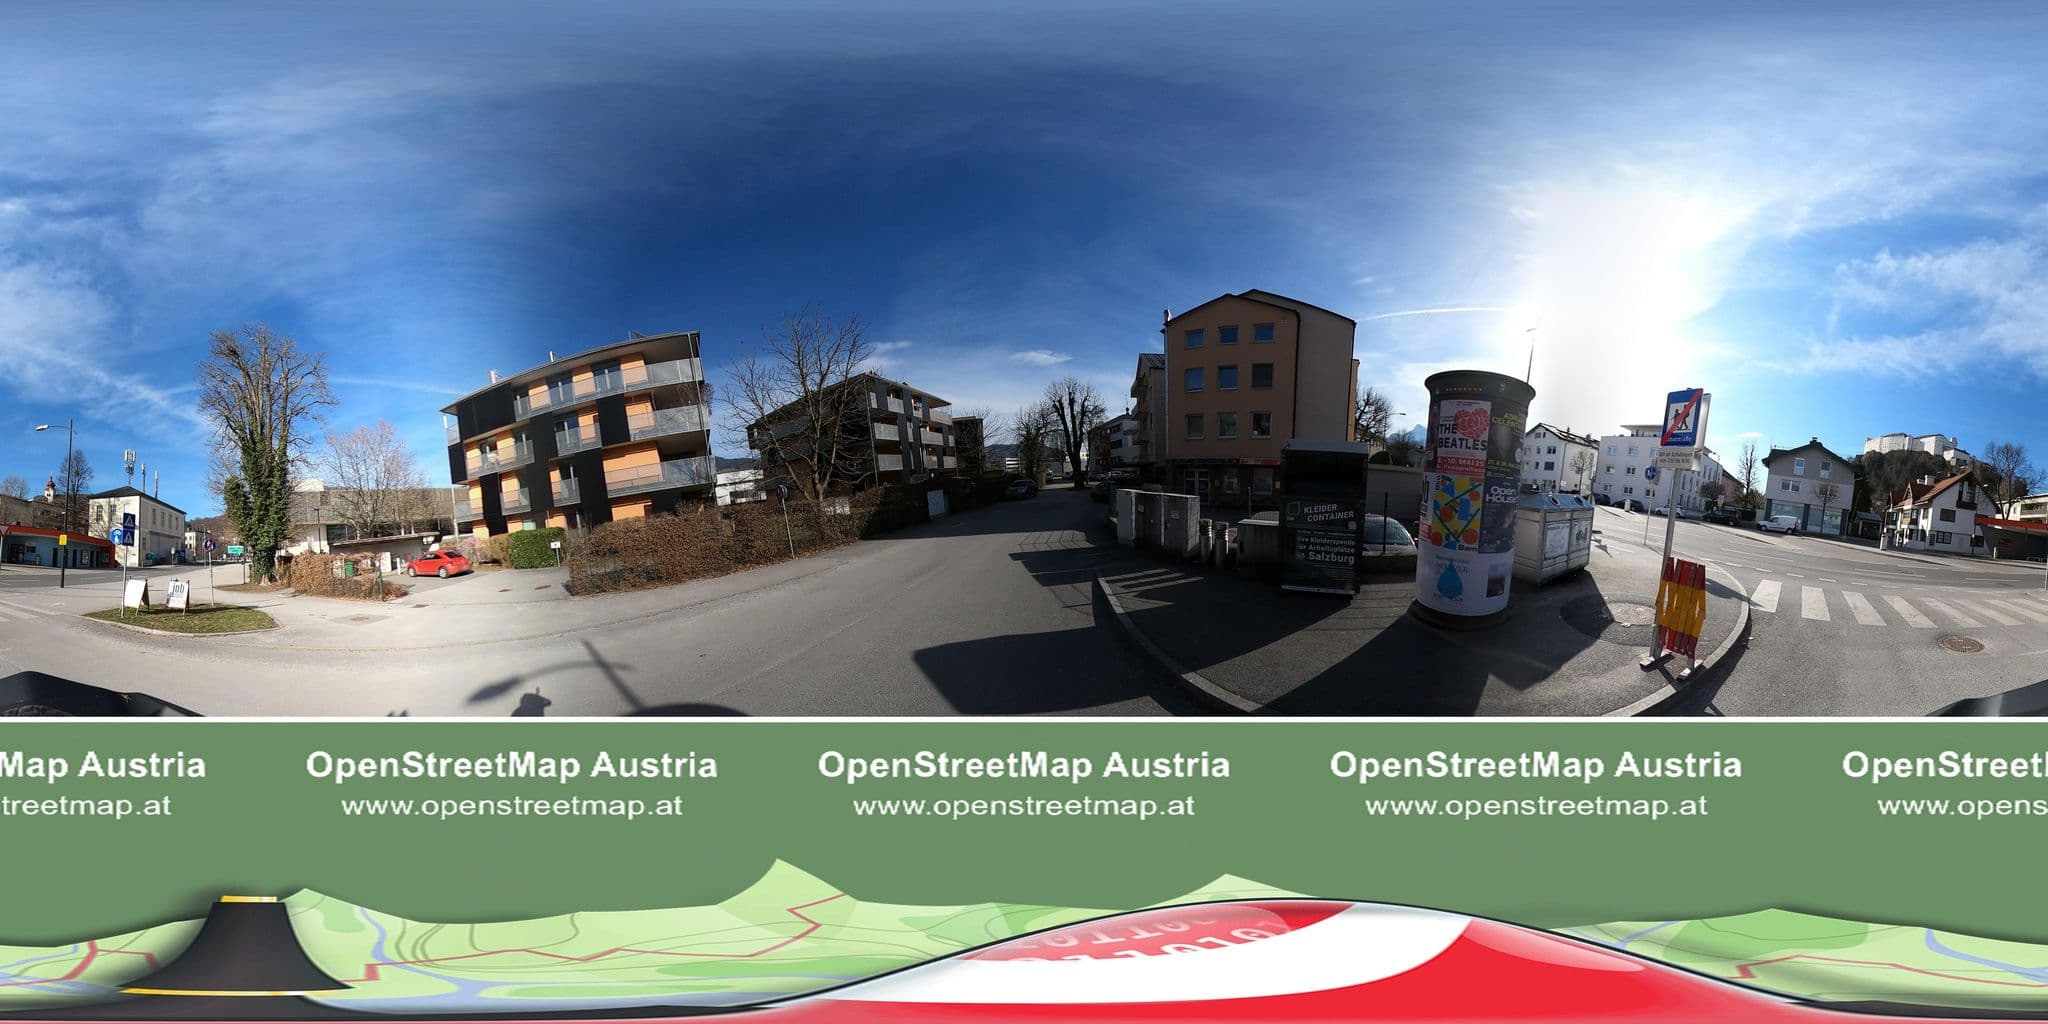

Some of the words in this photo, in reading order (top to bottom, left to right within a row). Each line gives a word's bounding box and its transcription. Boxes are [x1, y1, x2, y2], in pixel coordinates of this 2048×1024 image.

[1440, 423, 1458, 434] THE
[1439, 437, 1488, 451] BEATLES
[1490, 486, 1517, 496] Open
[1304, 503, 1337, 513] KLEIDER
[1307, 511, 1354, 521] CONTAINER
[1308, 551, 1355, 565] Salzburg
[172, 583, 185, 594] job
